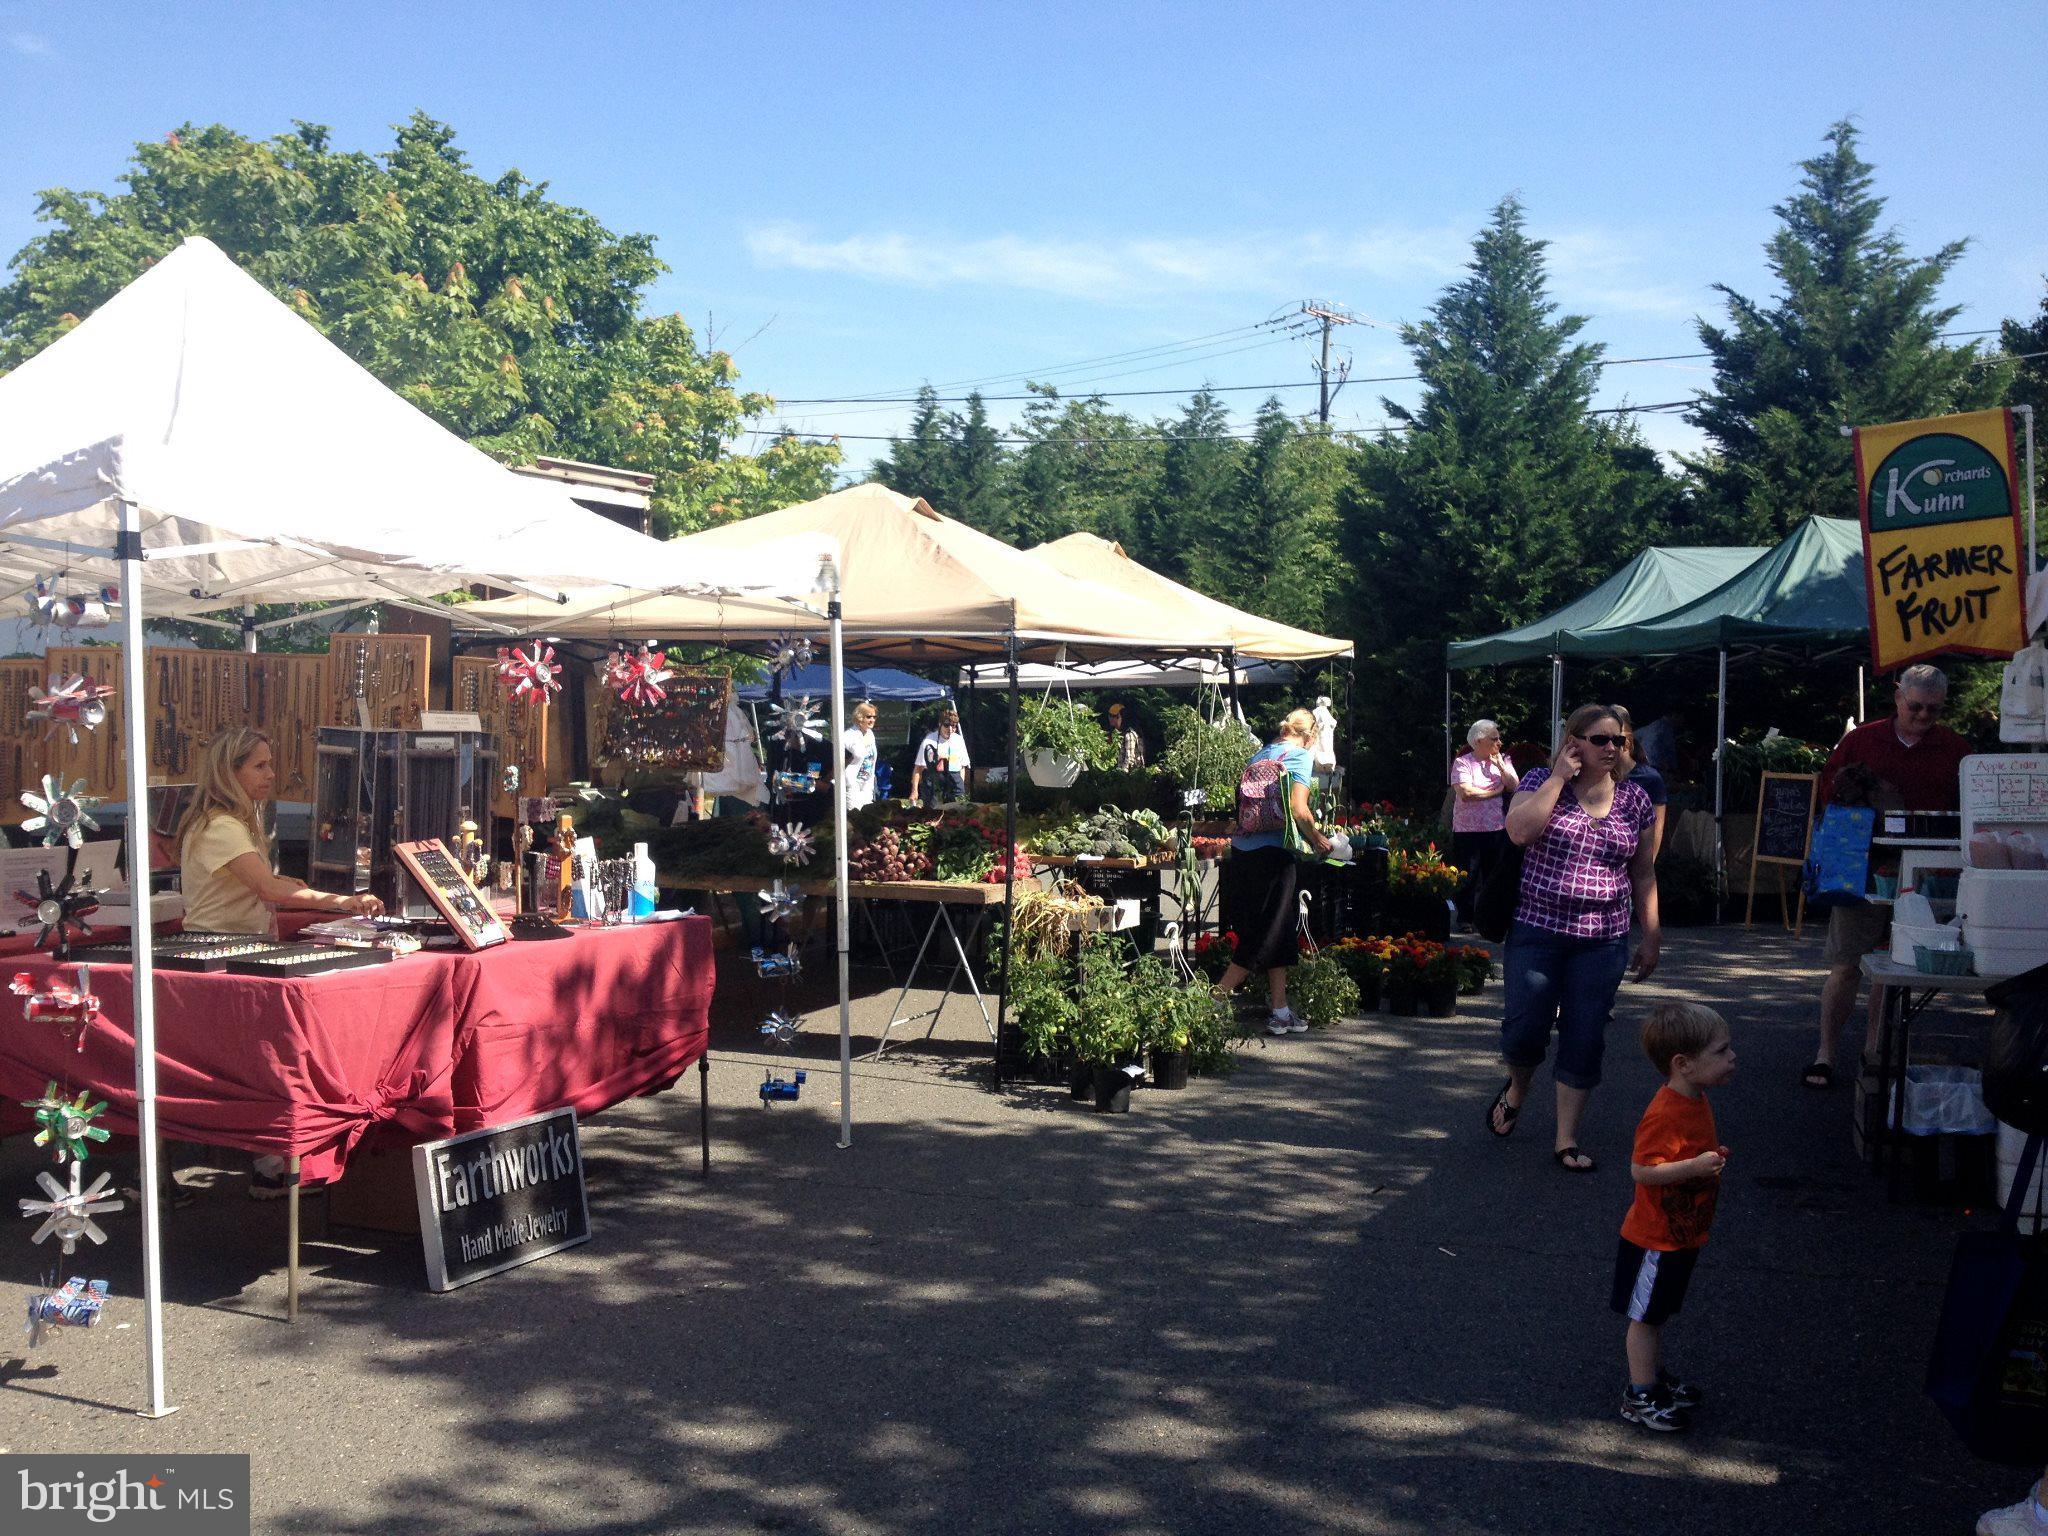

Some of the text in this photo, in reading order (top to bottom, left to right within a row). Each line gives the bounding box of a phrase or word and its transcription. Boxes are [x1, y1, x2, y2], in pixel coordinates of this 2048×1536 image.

[1885, 459, 1965, 518] Kuhn
[1878, 544, 2012, 596] FARMER
[1896, 585, 2000, 642] FRUIT
[437, 1125, 574, 1212] Earthworks
[461, 1207, 568, 1263] Hand Made Jewelry
